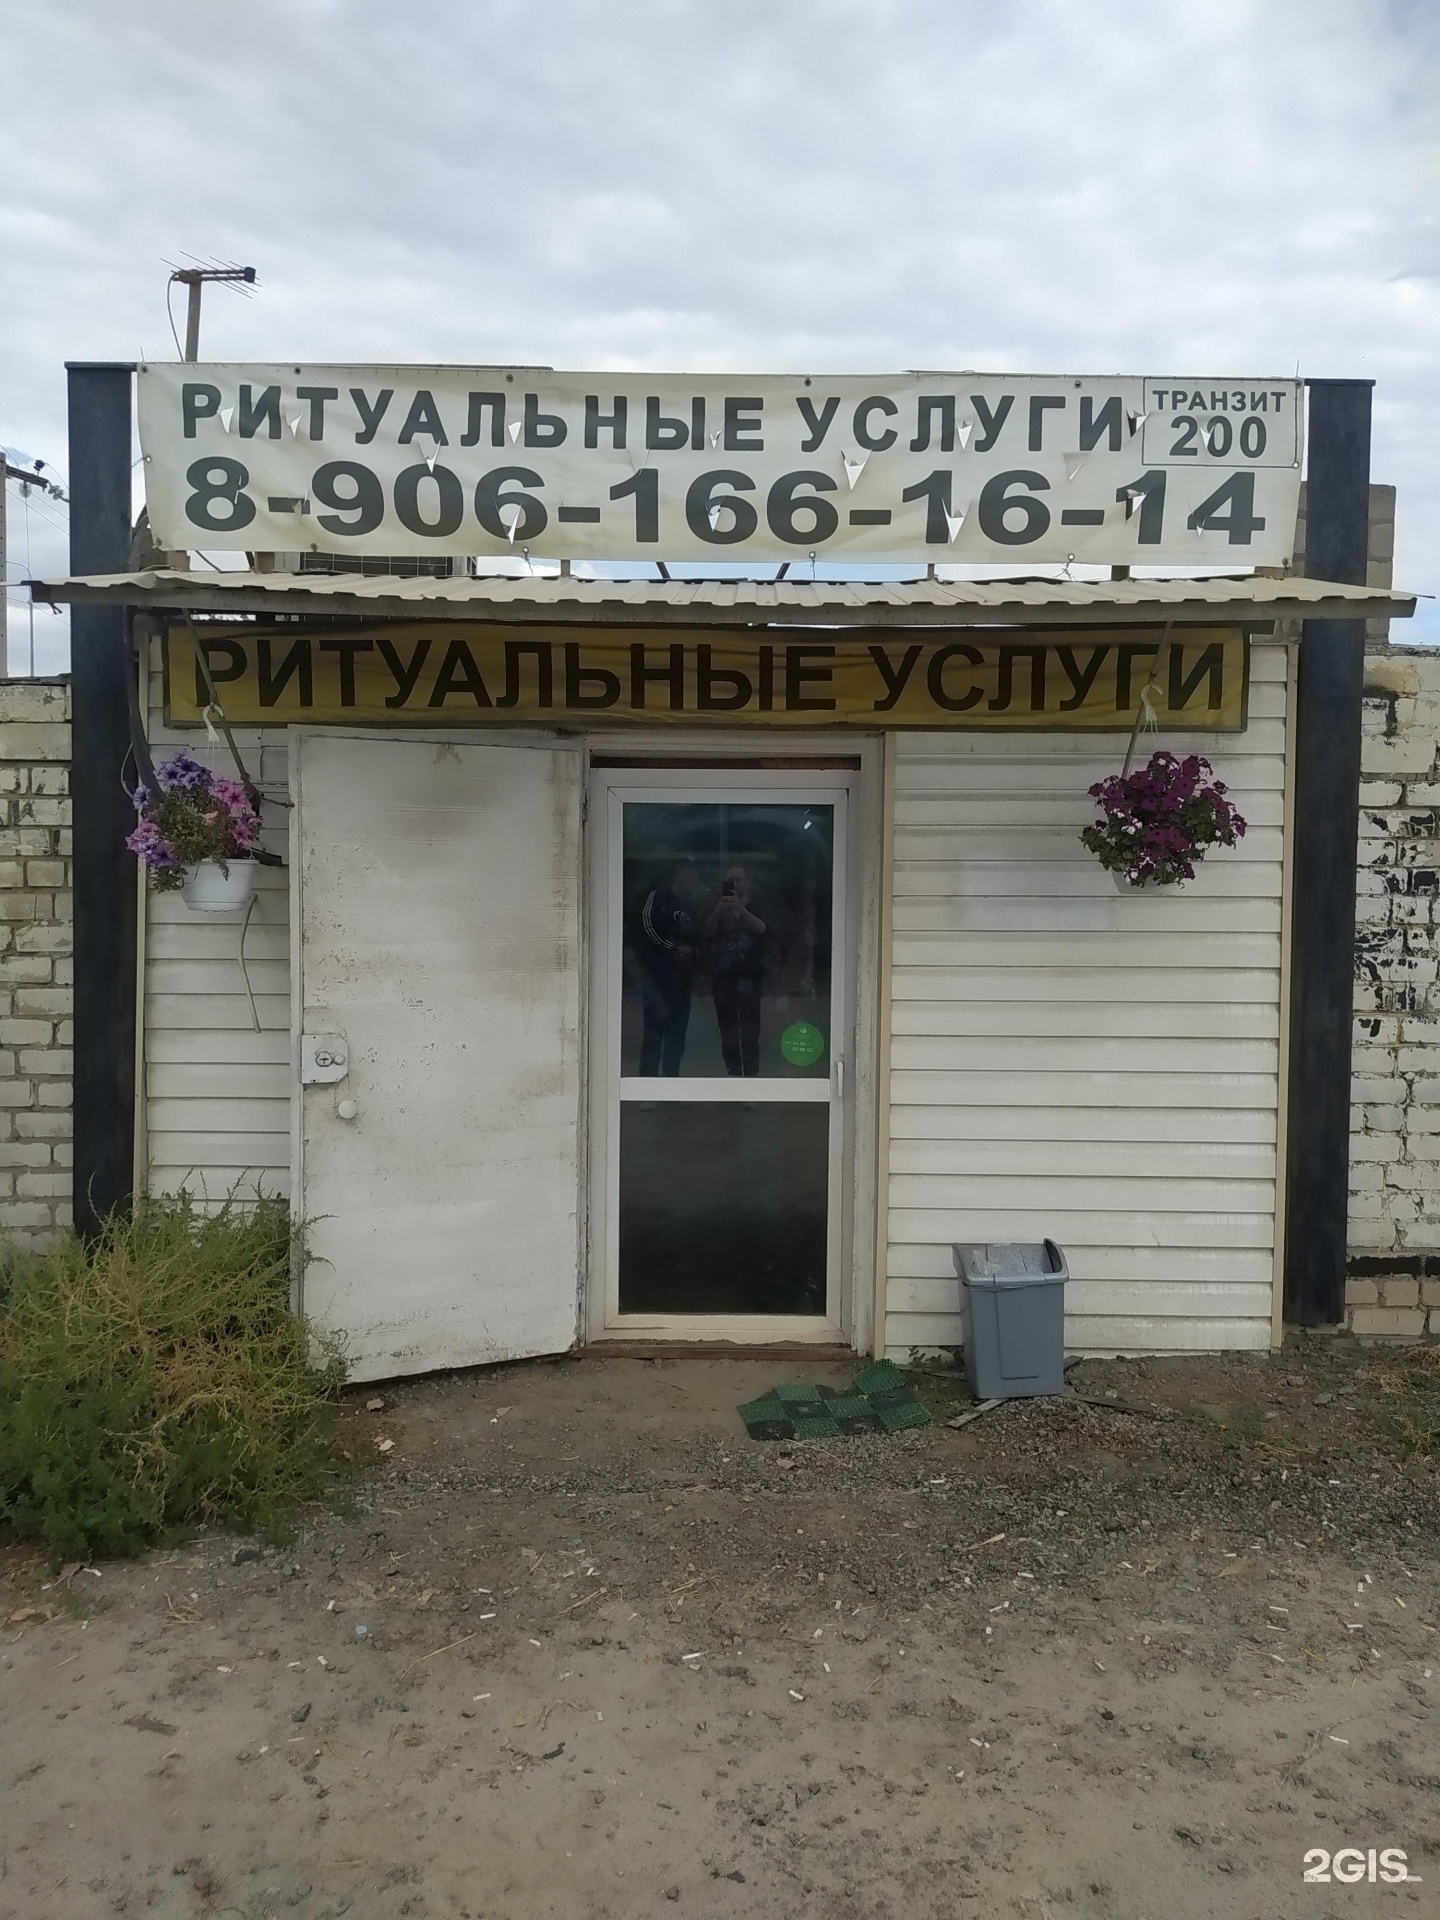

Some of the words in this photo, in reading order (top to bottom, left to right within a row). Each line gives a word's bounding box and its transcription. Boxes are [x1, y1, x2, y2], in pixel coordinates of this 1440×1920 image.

[181, 383, 764, 451] РИТУАЛЬНЫЕ
[795, 395, 1123, 453] УСЛУГИ
[1152, 390, 1287, 412] ТРАНЗИТ
[1169, 415, 1267, 458] 200
[185, 456, 1266, 546] 8-906-166-16-14
[196, 639, 836, 711] РИТУАЛЬНЫЕ
[867, 643, 1225, 711] УСЛУГИ
